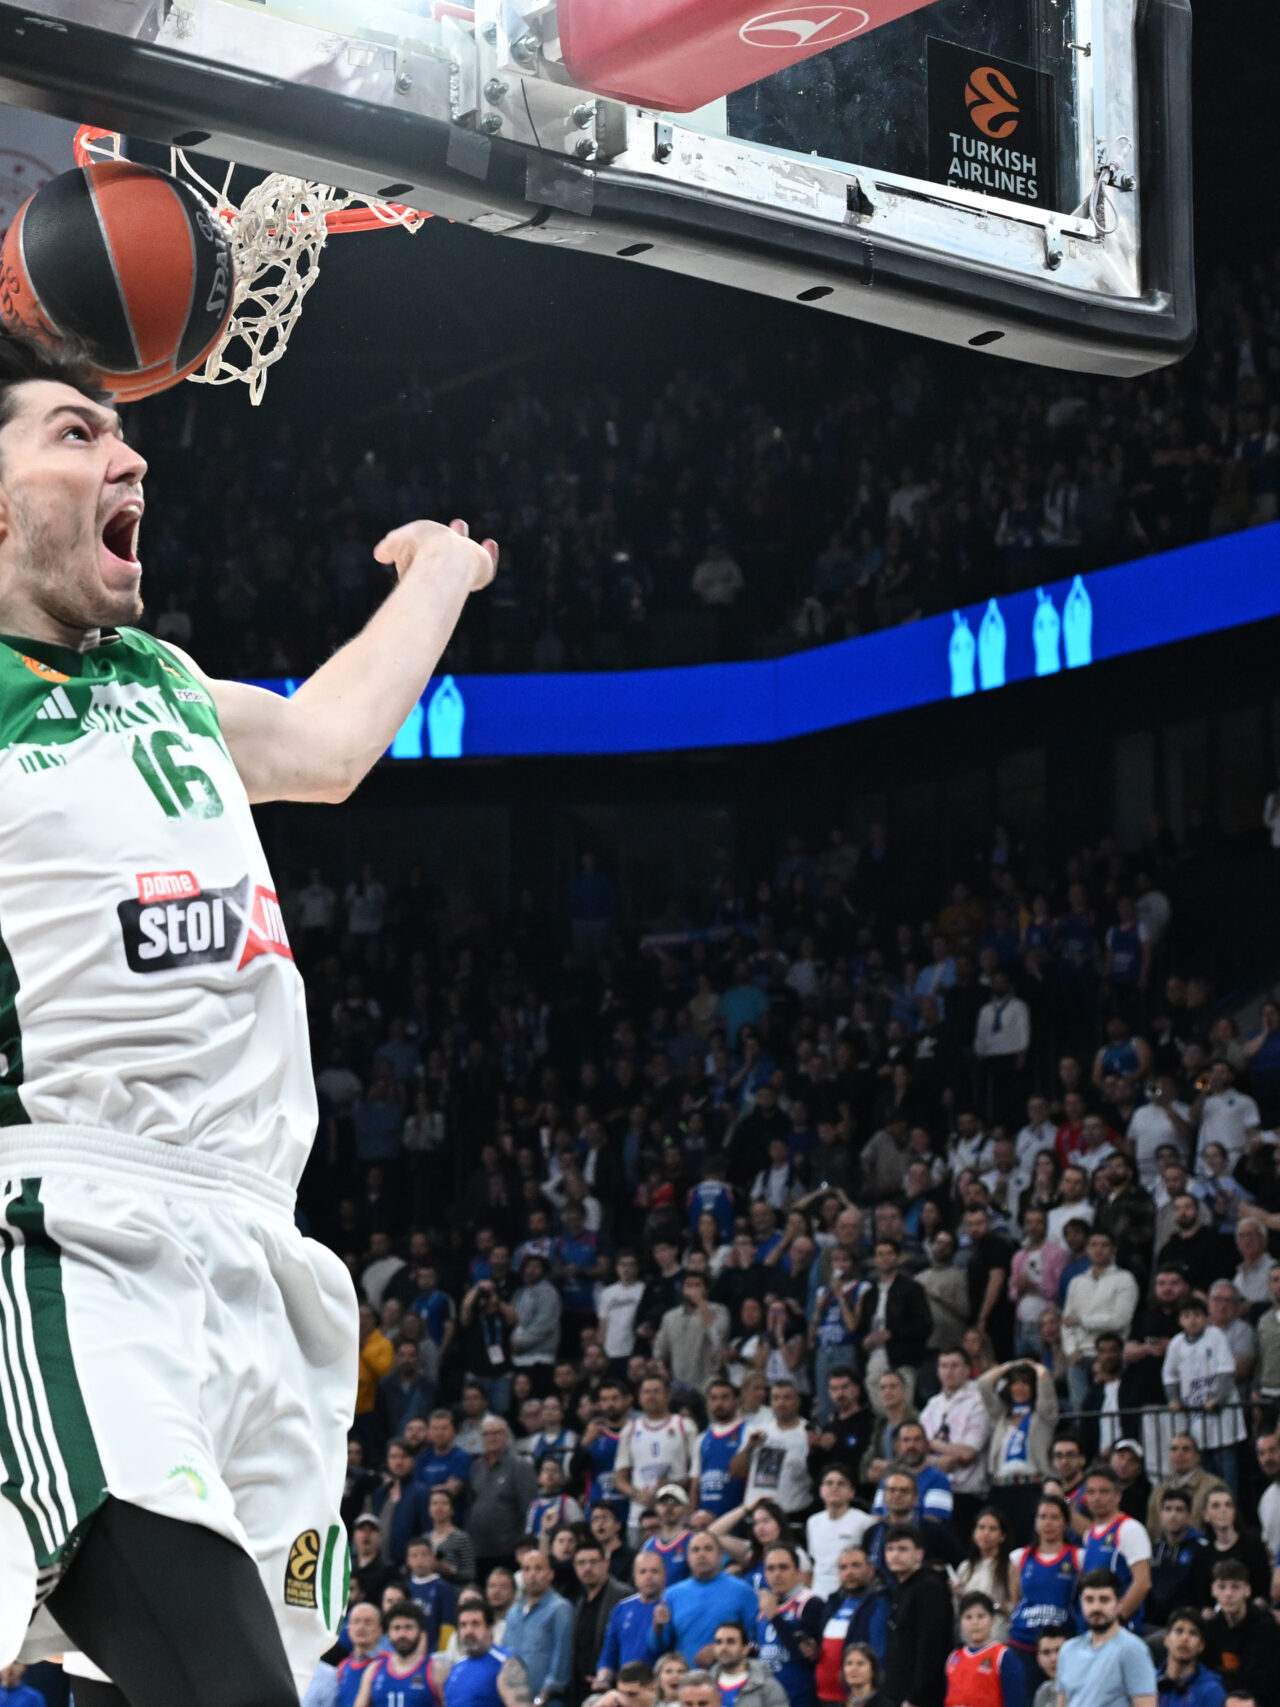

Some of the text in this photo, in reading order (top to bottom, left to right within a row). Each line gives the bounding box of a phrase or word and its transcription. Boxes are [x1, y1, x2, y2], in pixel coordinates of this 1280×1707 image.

[948, 132, 1037, 177] TURKISH
[947, 156, 1038, 200] AIRLINES
[130, 730, 224, 822] 16
[141, 873, 194, 899] pame
